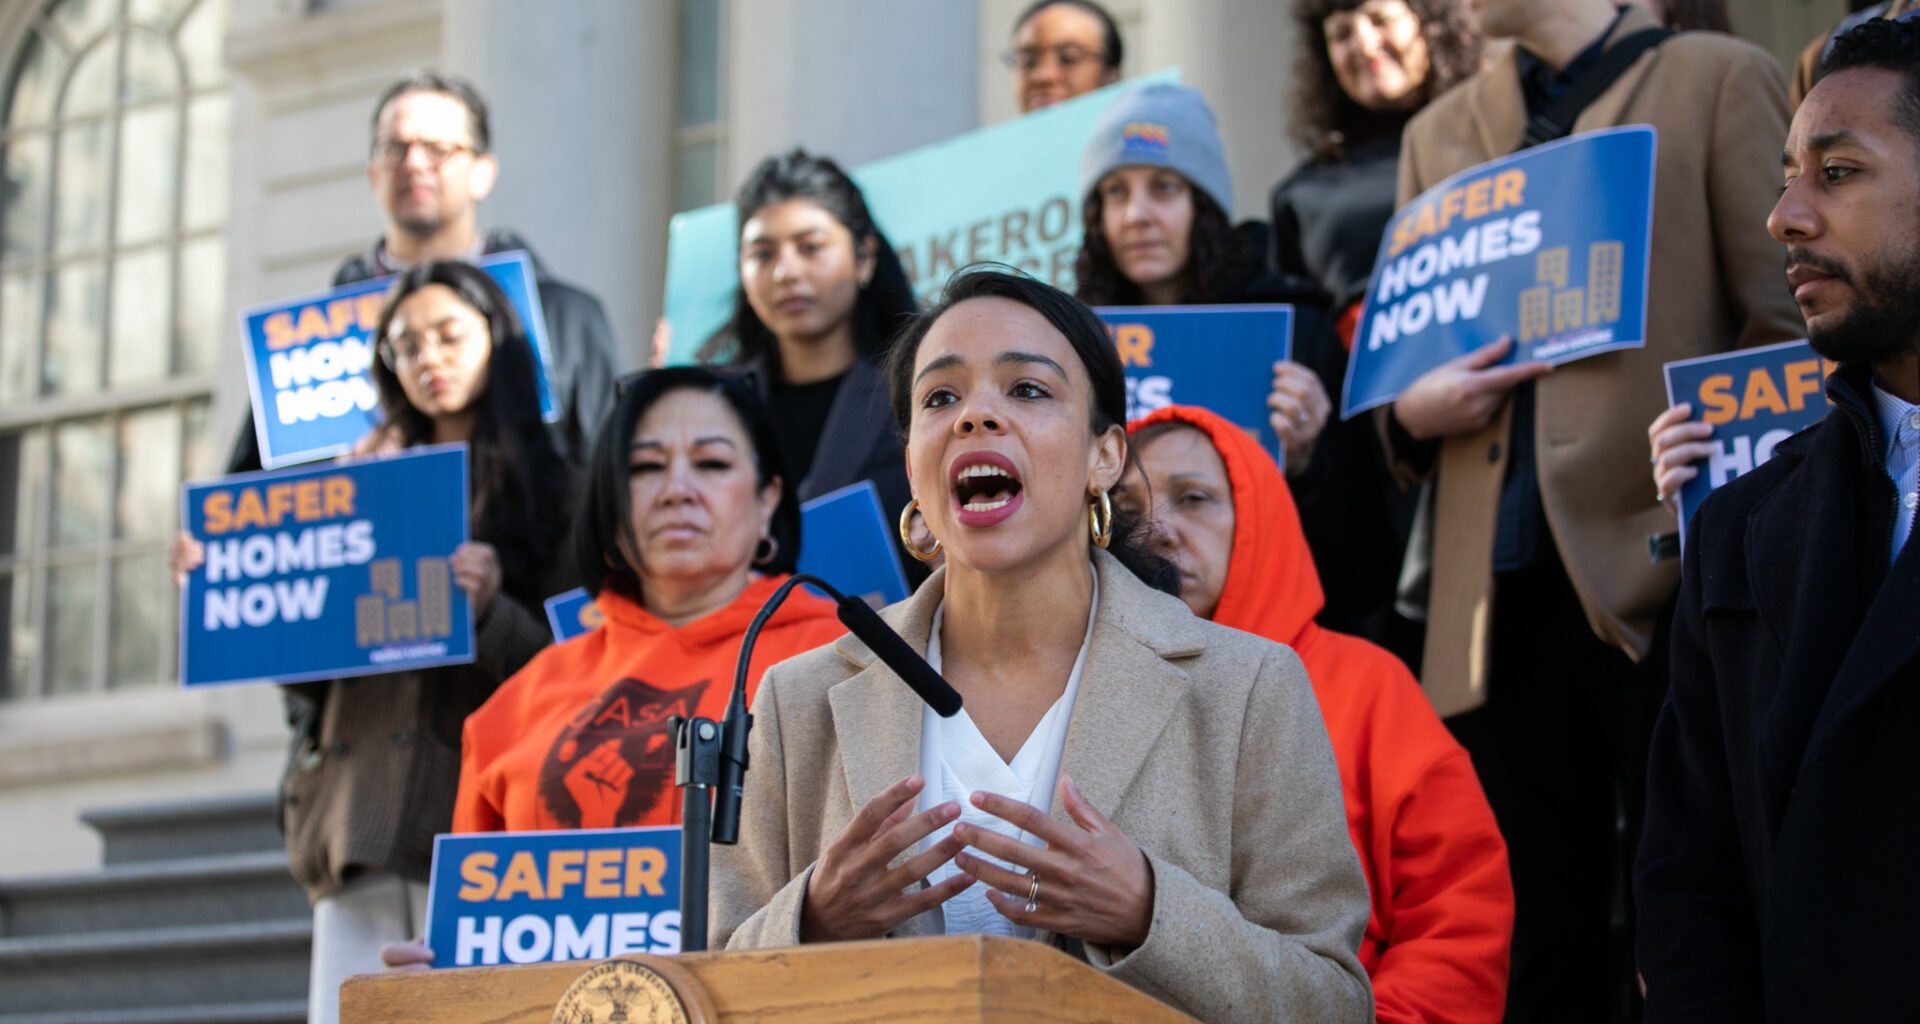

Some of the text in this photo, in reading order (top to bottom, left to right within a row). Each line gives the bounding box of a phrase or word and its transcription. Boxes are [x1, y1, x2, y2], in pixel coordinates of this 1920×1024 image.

[1388, 168, 1527, 258] SAFER
[1377, 209, 1542, 305] HOMES
[263, 291, 382, 351] SAFE
[1368, 272, 1490, 351] NOW
[269, 336, 372, 390] HOM
[1699, 357, 1839, 425] SAF
[203, 473, 357, 535] SAFER
[205, 518, 376, 584] HOMES
[203, 574, 329, 631] NOW
[458, 846, 668, 902] SAFER
[455, 909, 682, 965] HOMES
